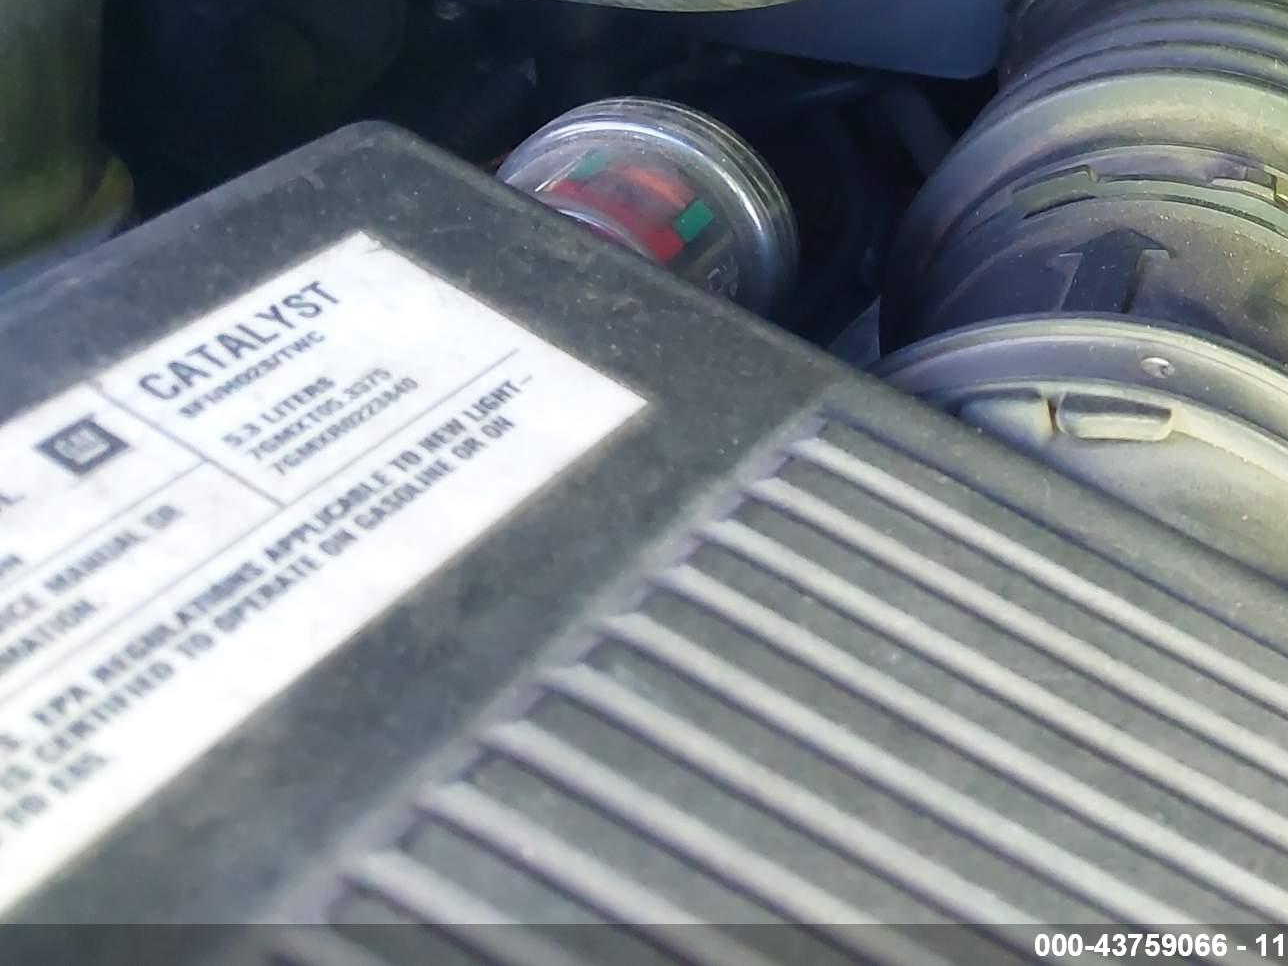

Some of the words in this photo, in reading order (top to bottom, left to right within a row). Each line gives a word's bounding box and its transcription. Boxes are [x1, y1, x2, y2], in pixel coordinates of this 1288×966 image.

[138, 281, 339, 400] CATALYST
[222, 422, 262, 448] 5.3
[260, 377, 335, 424] LITERS
[43, 530, 148, 595] MANUAL
[141, 504, 184, 530] OR
[174, 632, 215, 660] TO
[213, 555, 322, 632] OPERATE
[318, 528, 358, 556] ON
[353, 458, 456, 530] GASOLINE
[451, 437, 486, 460] OR
[480, 416, 515, 439] ON
[264, 471, 392, 564] APPLICABLE
[388, 450, 422, 472] TO
[418, 418, 467, 453] NEW
